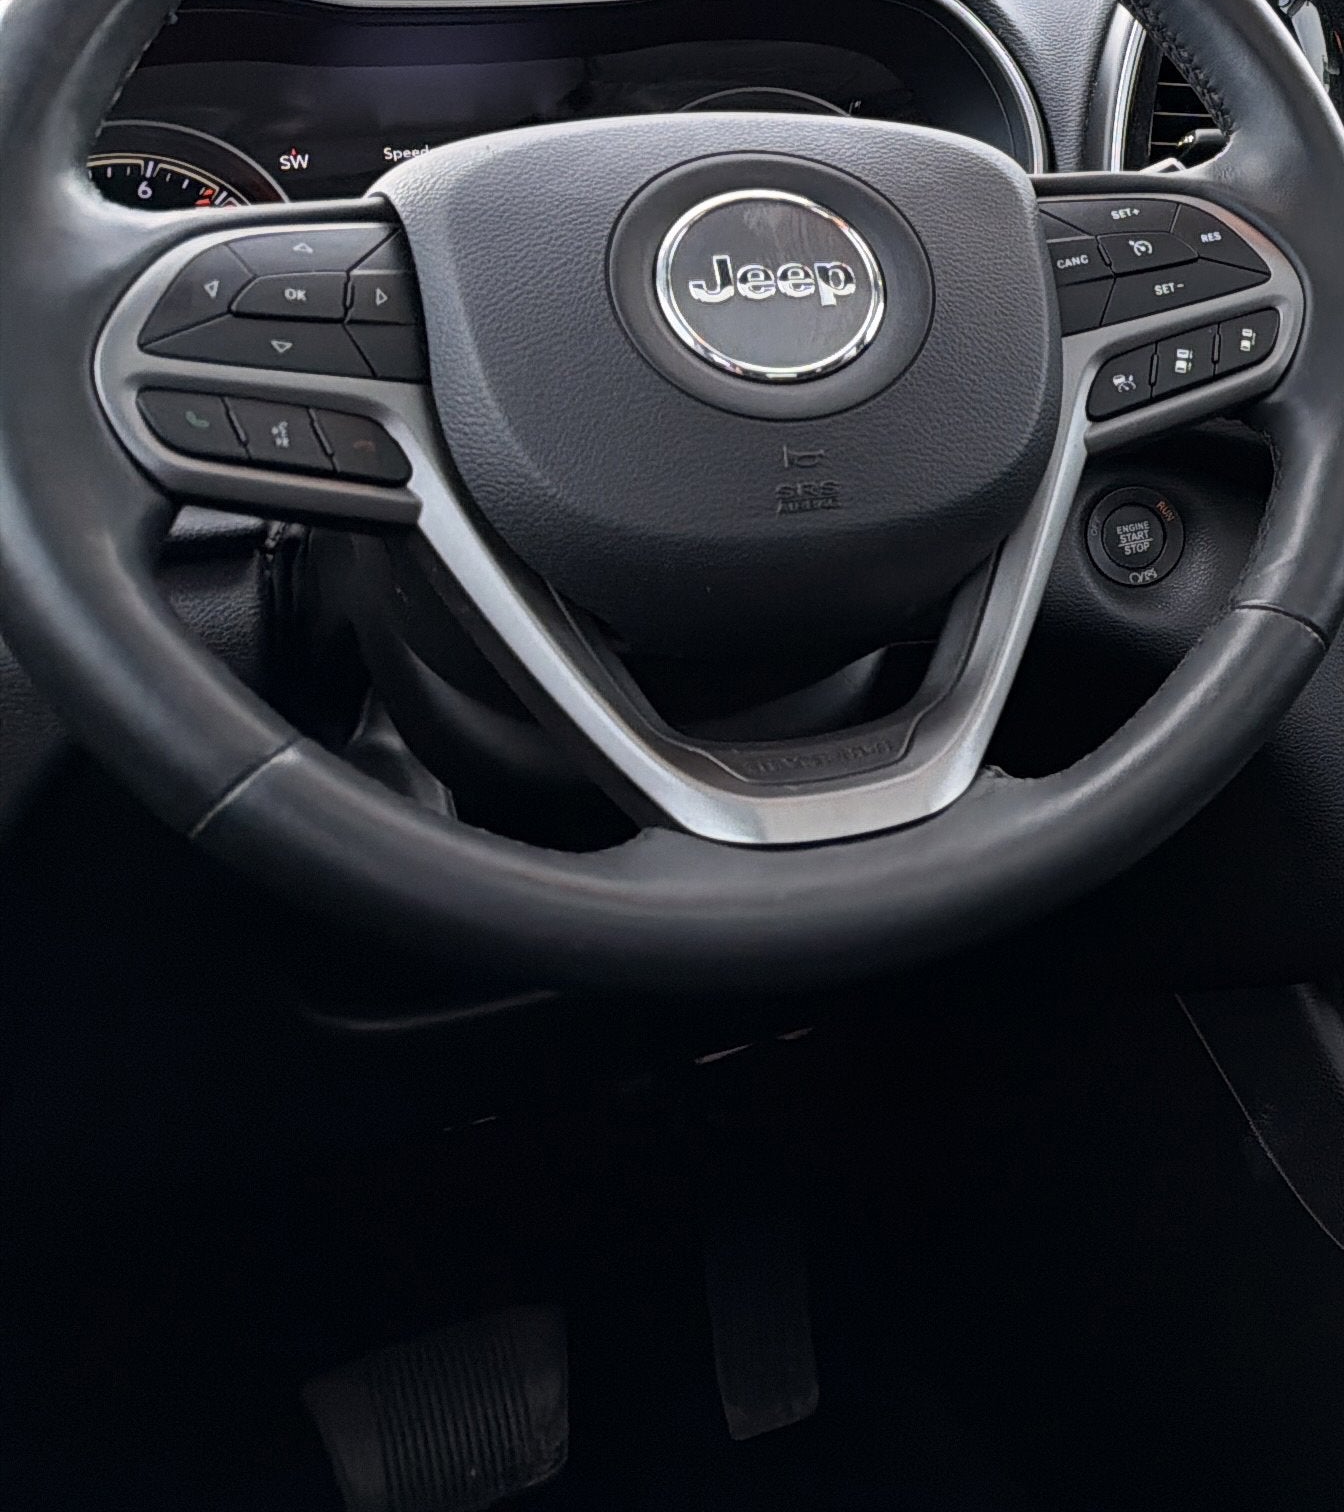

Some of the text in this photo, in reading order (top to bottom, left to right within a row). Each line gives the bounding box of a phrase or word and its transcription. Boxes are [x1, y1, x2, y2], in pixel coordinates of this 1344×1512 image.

[279, 153, 309, 170] SW
[138, 180, 153, 199] 6
[1200, 231, 1222, 243] RES
[1056, 254, 1089, 269] CANC
[688, 253, 857, 306] Jeep
[284, 288, 306, 301] OK
[775, 480, 841, 498] SRS
[1156, 500, 1176, 522] RUN
[1116, 520, 1150, 535] ENGINE
[1119, 530, 1150, 544] START
[1124, 541, 1150, 556] STOP
